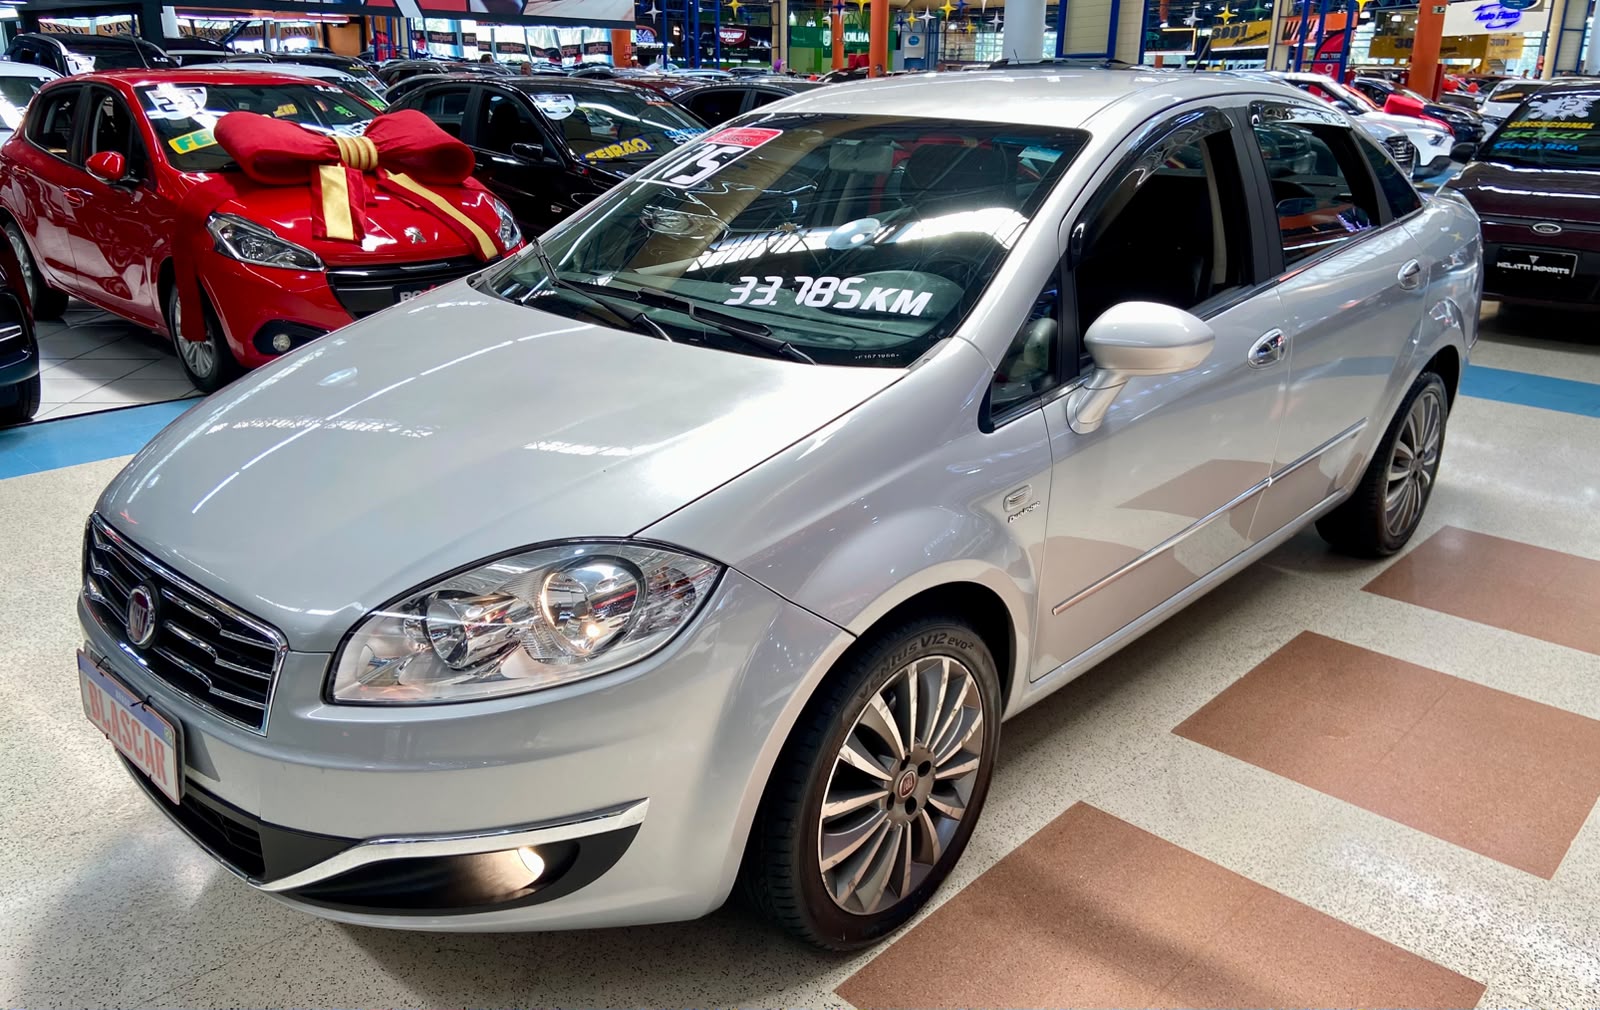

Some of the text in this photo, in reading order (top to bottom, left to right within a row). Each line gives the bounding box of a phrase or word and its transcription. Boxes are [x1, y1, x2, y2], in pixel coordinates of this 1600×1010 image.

[1212, 24, 1248, 40] 3001
[920, 632, 948, 648] V12
[87, 679, 168, 786] BLASCAR
